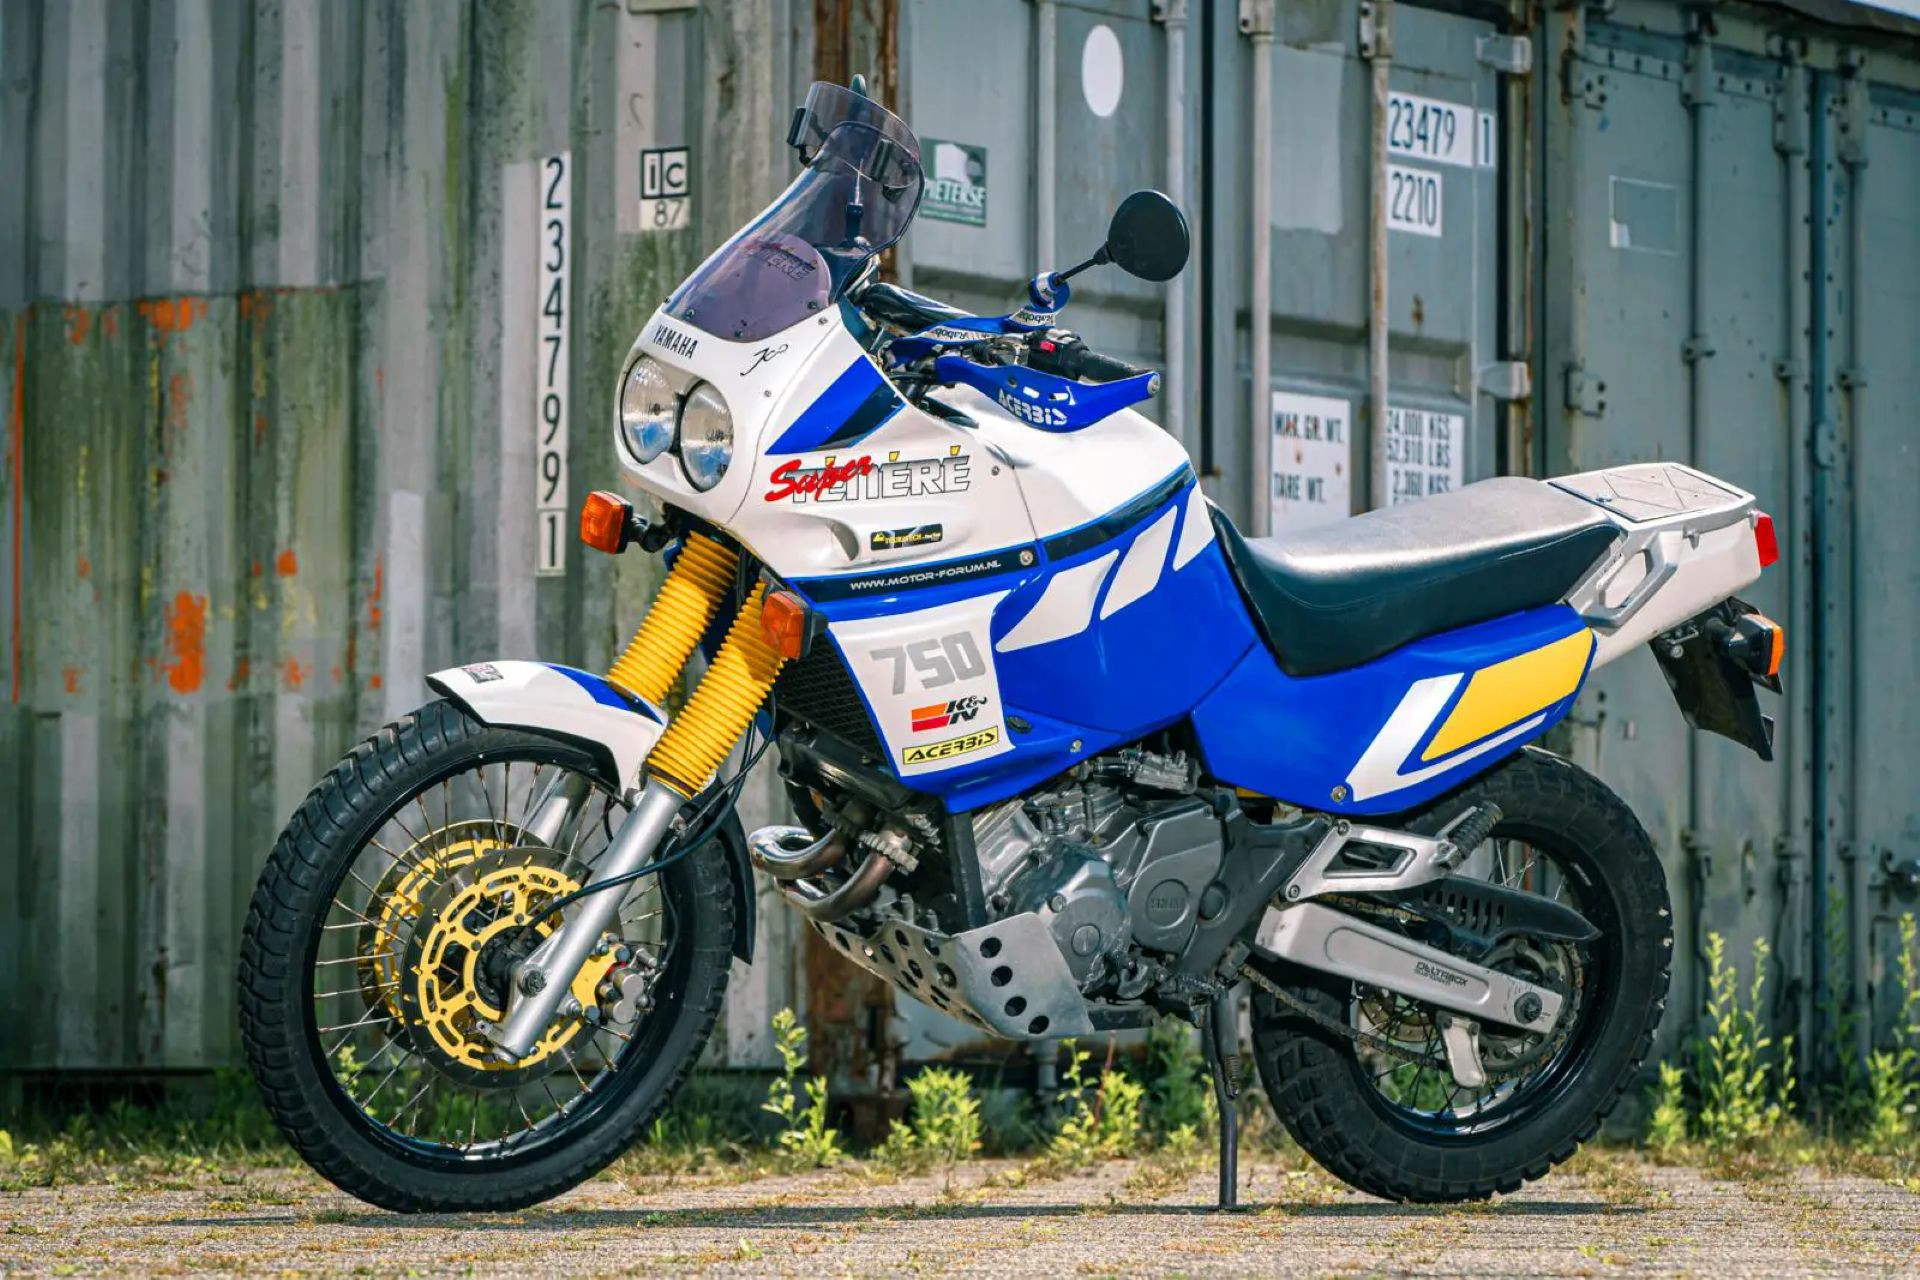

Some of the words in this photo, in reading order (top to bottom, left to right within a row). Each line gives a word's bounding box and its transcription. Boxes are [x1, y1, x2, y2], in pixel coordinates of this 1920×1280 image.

[1389, 98, 1456, 154] 23479
[1483, 117, 1490, 165] 1
[653, 200, 683, 228] 87
[1392, 171, 1437, 226] 2210
[653, 325, 698, 360] YAMAHA
[764, 455, 872, 502] Super
[869, 631, 986, 695] 750
